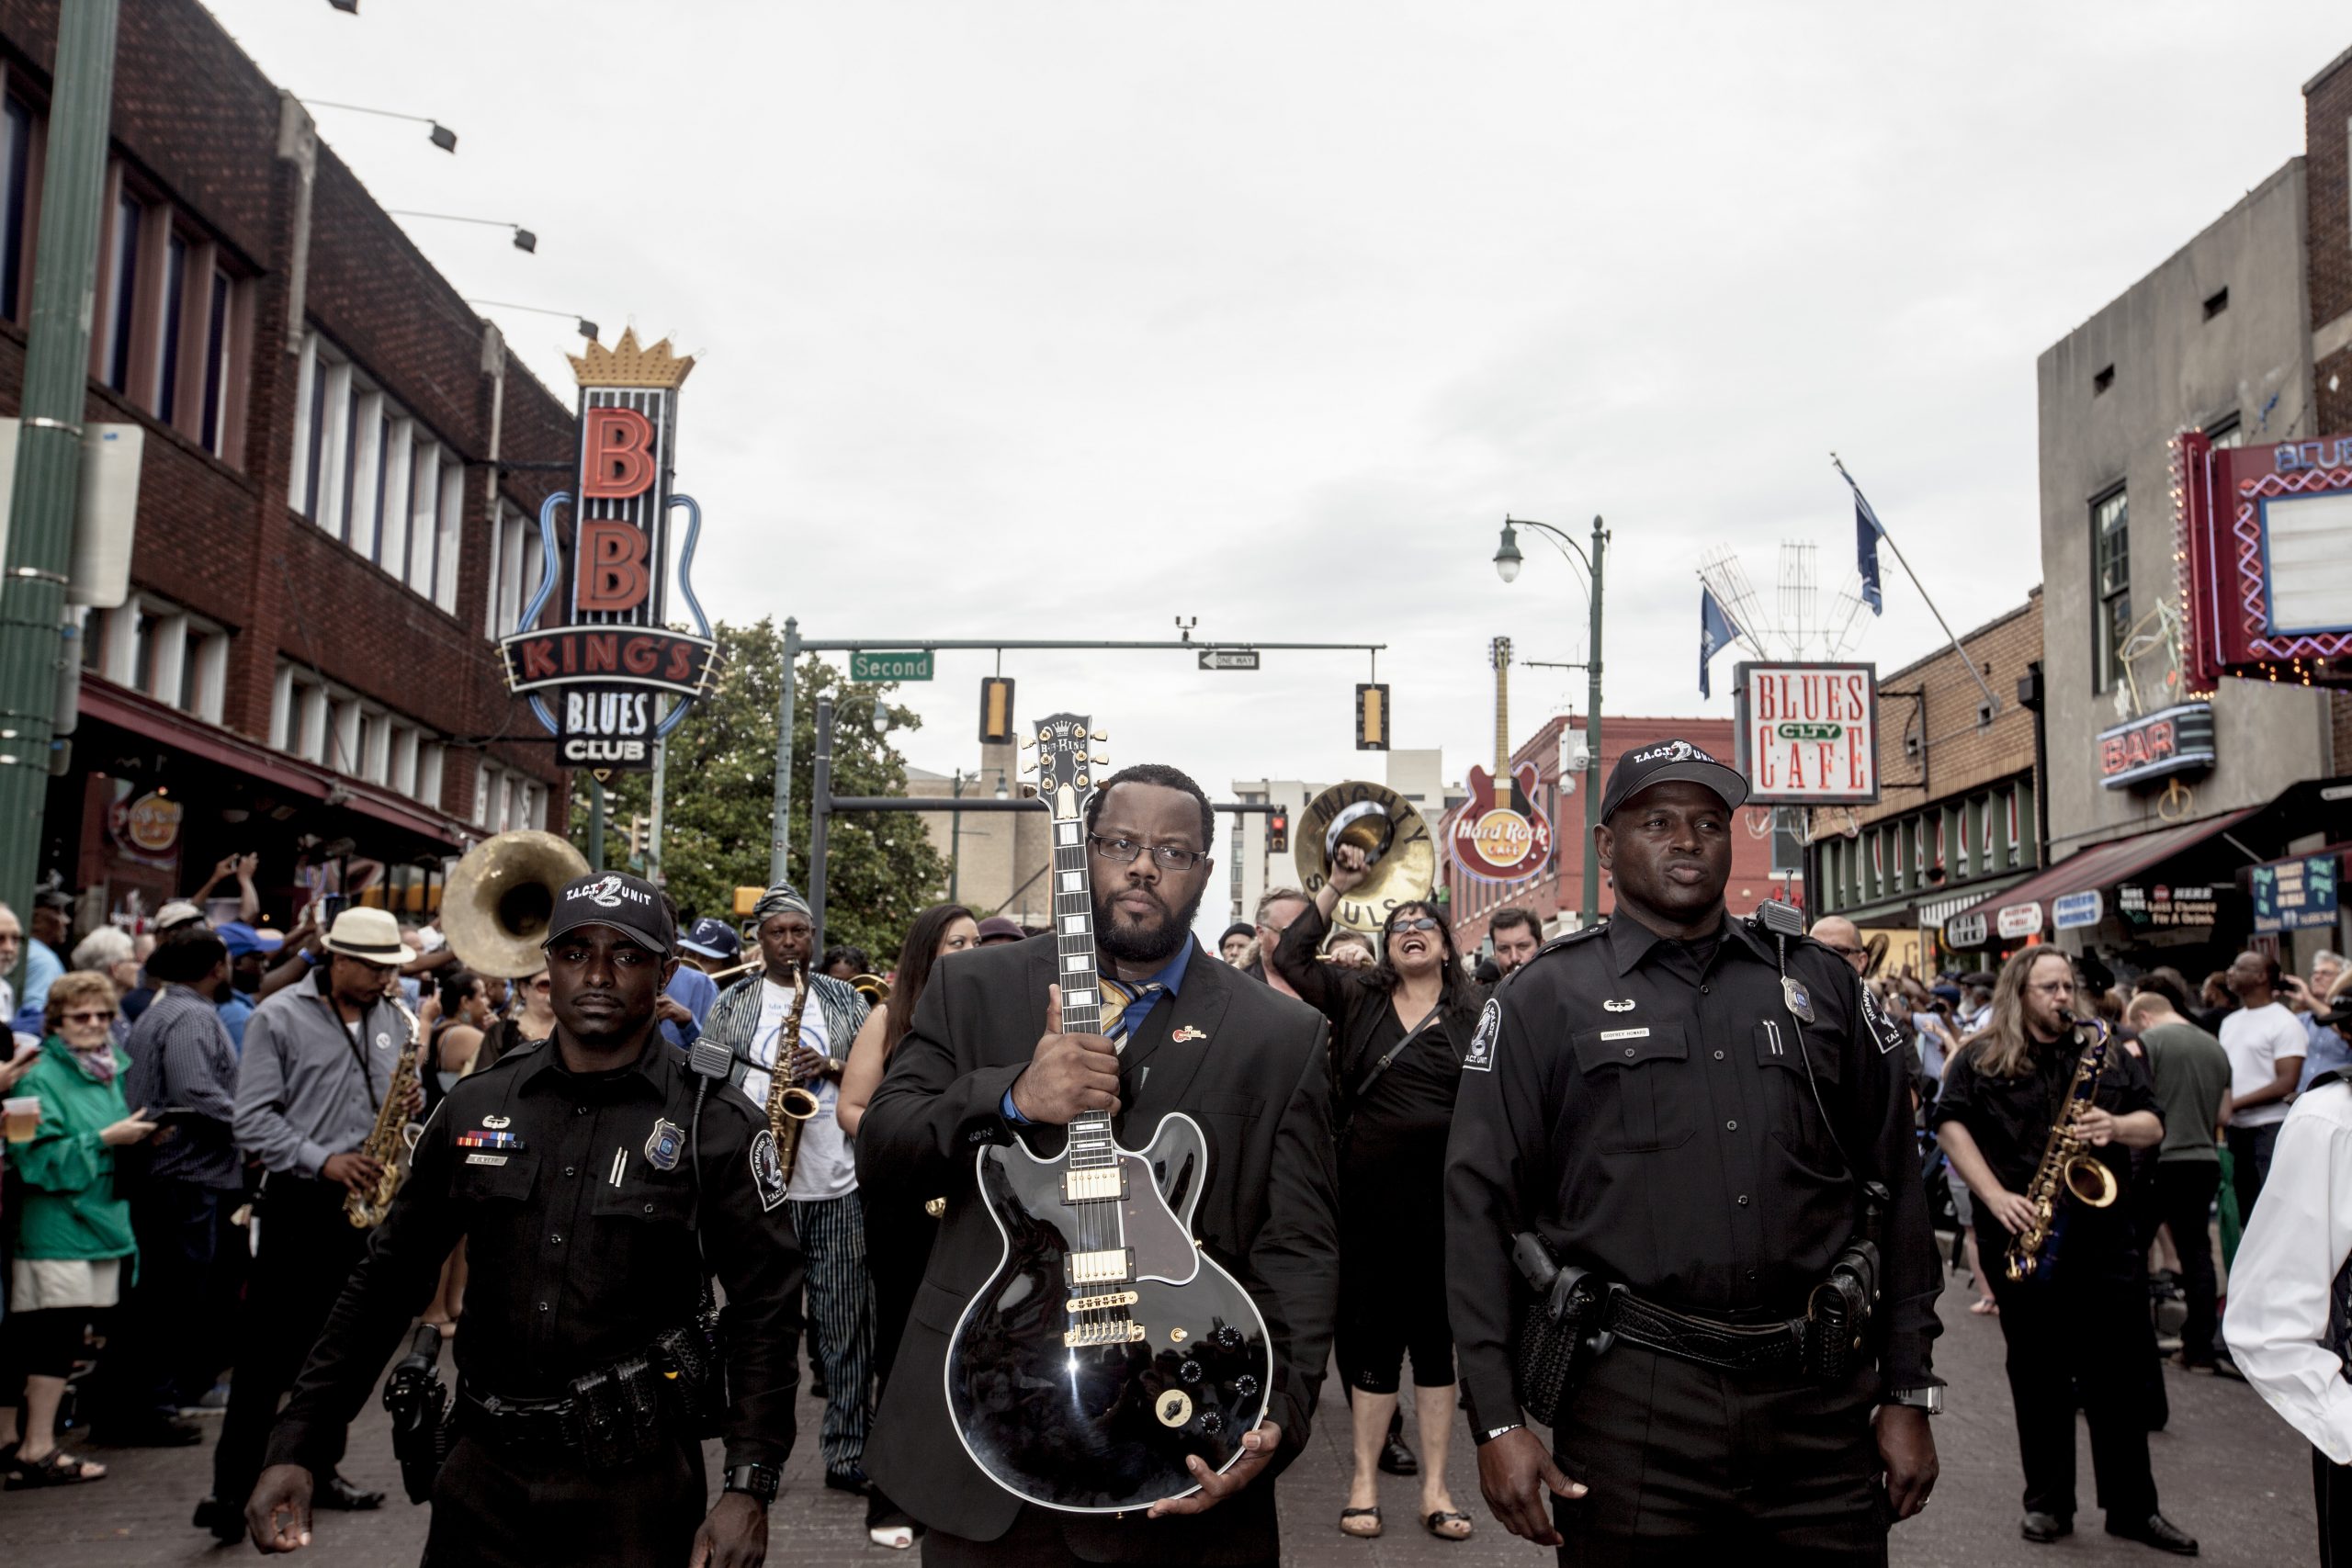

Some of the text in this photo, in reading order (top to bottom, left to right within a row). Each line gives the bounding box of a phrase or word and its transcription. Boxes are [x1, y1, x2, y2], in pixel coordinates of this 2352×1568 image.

[582, 407, 655, 499] B
[577, 519, 650, 612] B
[521, 633, 693, 681] KING'S
[855, 657, 927, 677] Second
[1216, 656, 1252, 665] ONE WAY
[566, 691, 649, 736] BLUES
[1757, 674, 1864, 720] BLUES
[565, 739, 645, 761] CLUB
[1781, 724, 1837, 738] CITY
[2101, 720, 2176, 774] BAR
[1759, 726, 1865, 789] CAFE
[1311, 784, 1430, 844] MIGHTY
[1457, 819, 1548, 845] Hard Rock
[567, 883, 651, 906] T.A.C.T. UNIT
[1306, 873, 1397, 928] SULS
[754, 1138, 766, 1177] MEMPHIS
